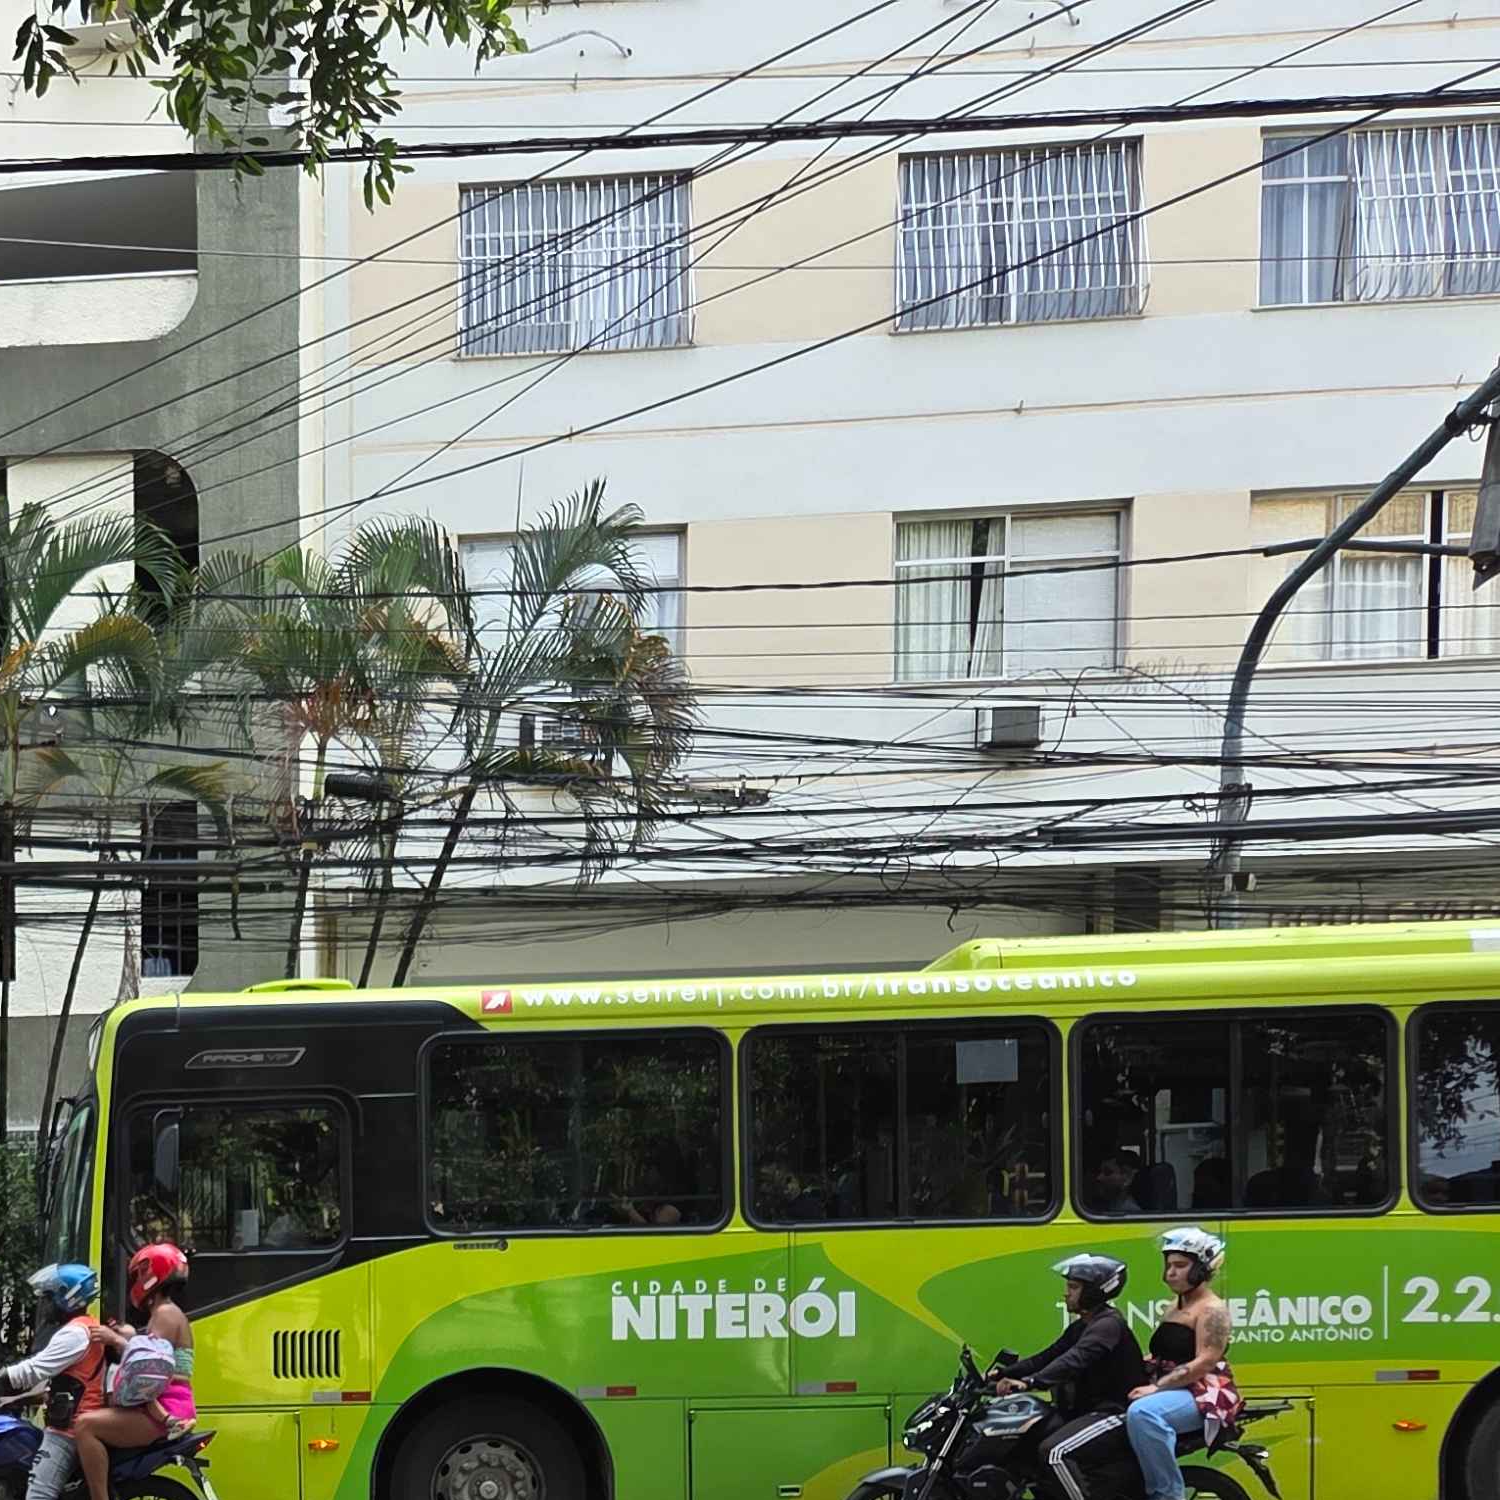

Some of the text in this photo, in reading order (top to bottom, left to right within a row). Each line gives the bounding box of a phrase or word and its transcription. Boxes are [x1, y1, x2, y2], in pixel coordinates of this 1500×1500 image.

[611, 1278, 786, 1295] CIDADE DE
[611, 1277, 856, 1341] NITERÓI
[1228, 1325, 1374, 1344] SANTO ANTÔNIO
